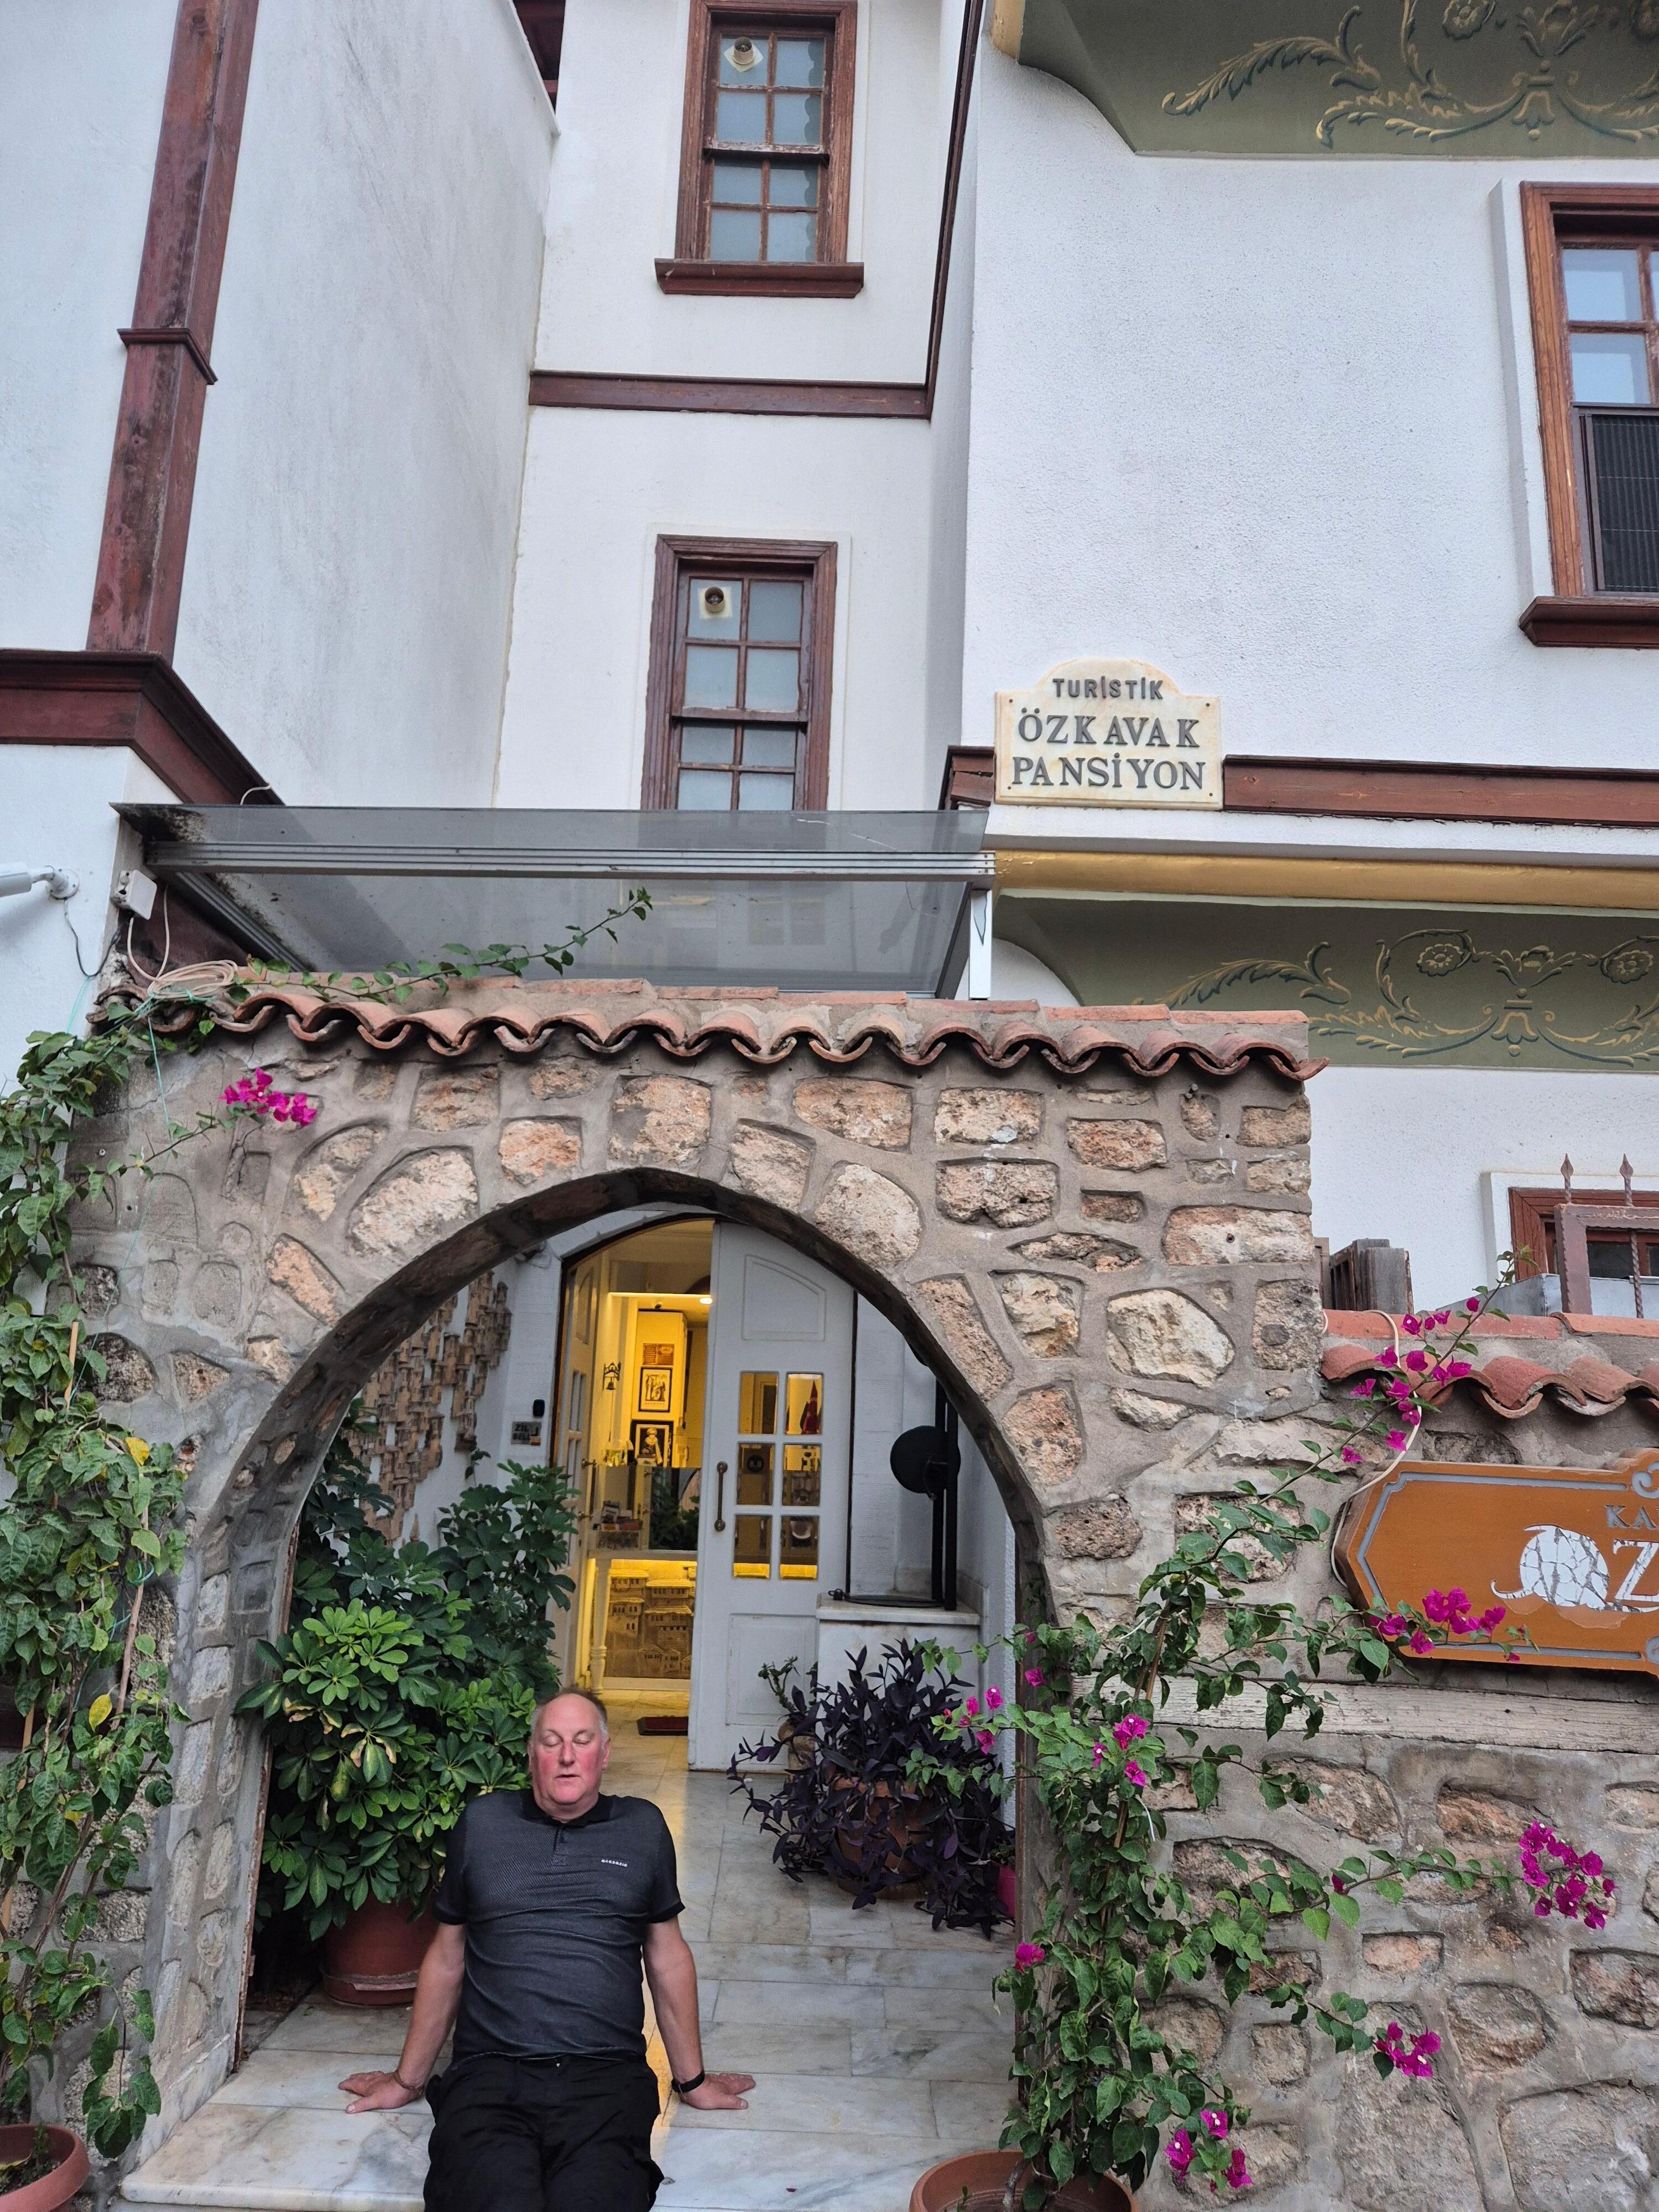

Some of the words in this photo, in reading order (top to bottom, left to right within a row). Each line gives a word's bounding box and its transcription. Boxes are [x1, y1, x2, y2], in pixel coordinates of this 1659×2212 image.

[1052, 675, 1164, 700] TURİSTİK
[1018, 707, 1200, 748] ÖZKAVAK
[1011, 752, 1206, 790] PANSİYON
[1604, 1504, 1659, 1530] KA
